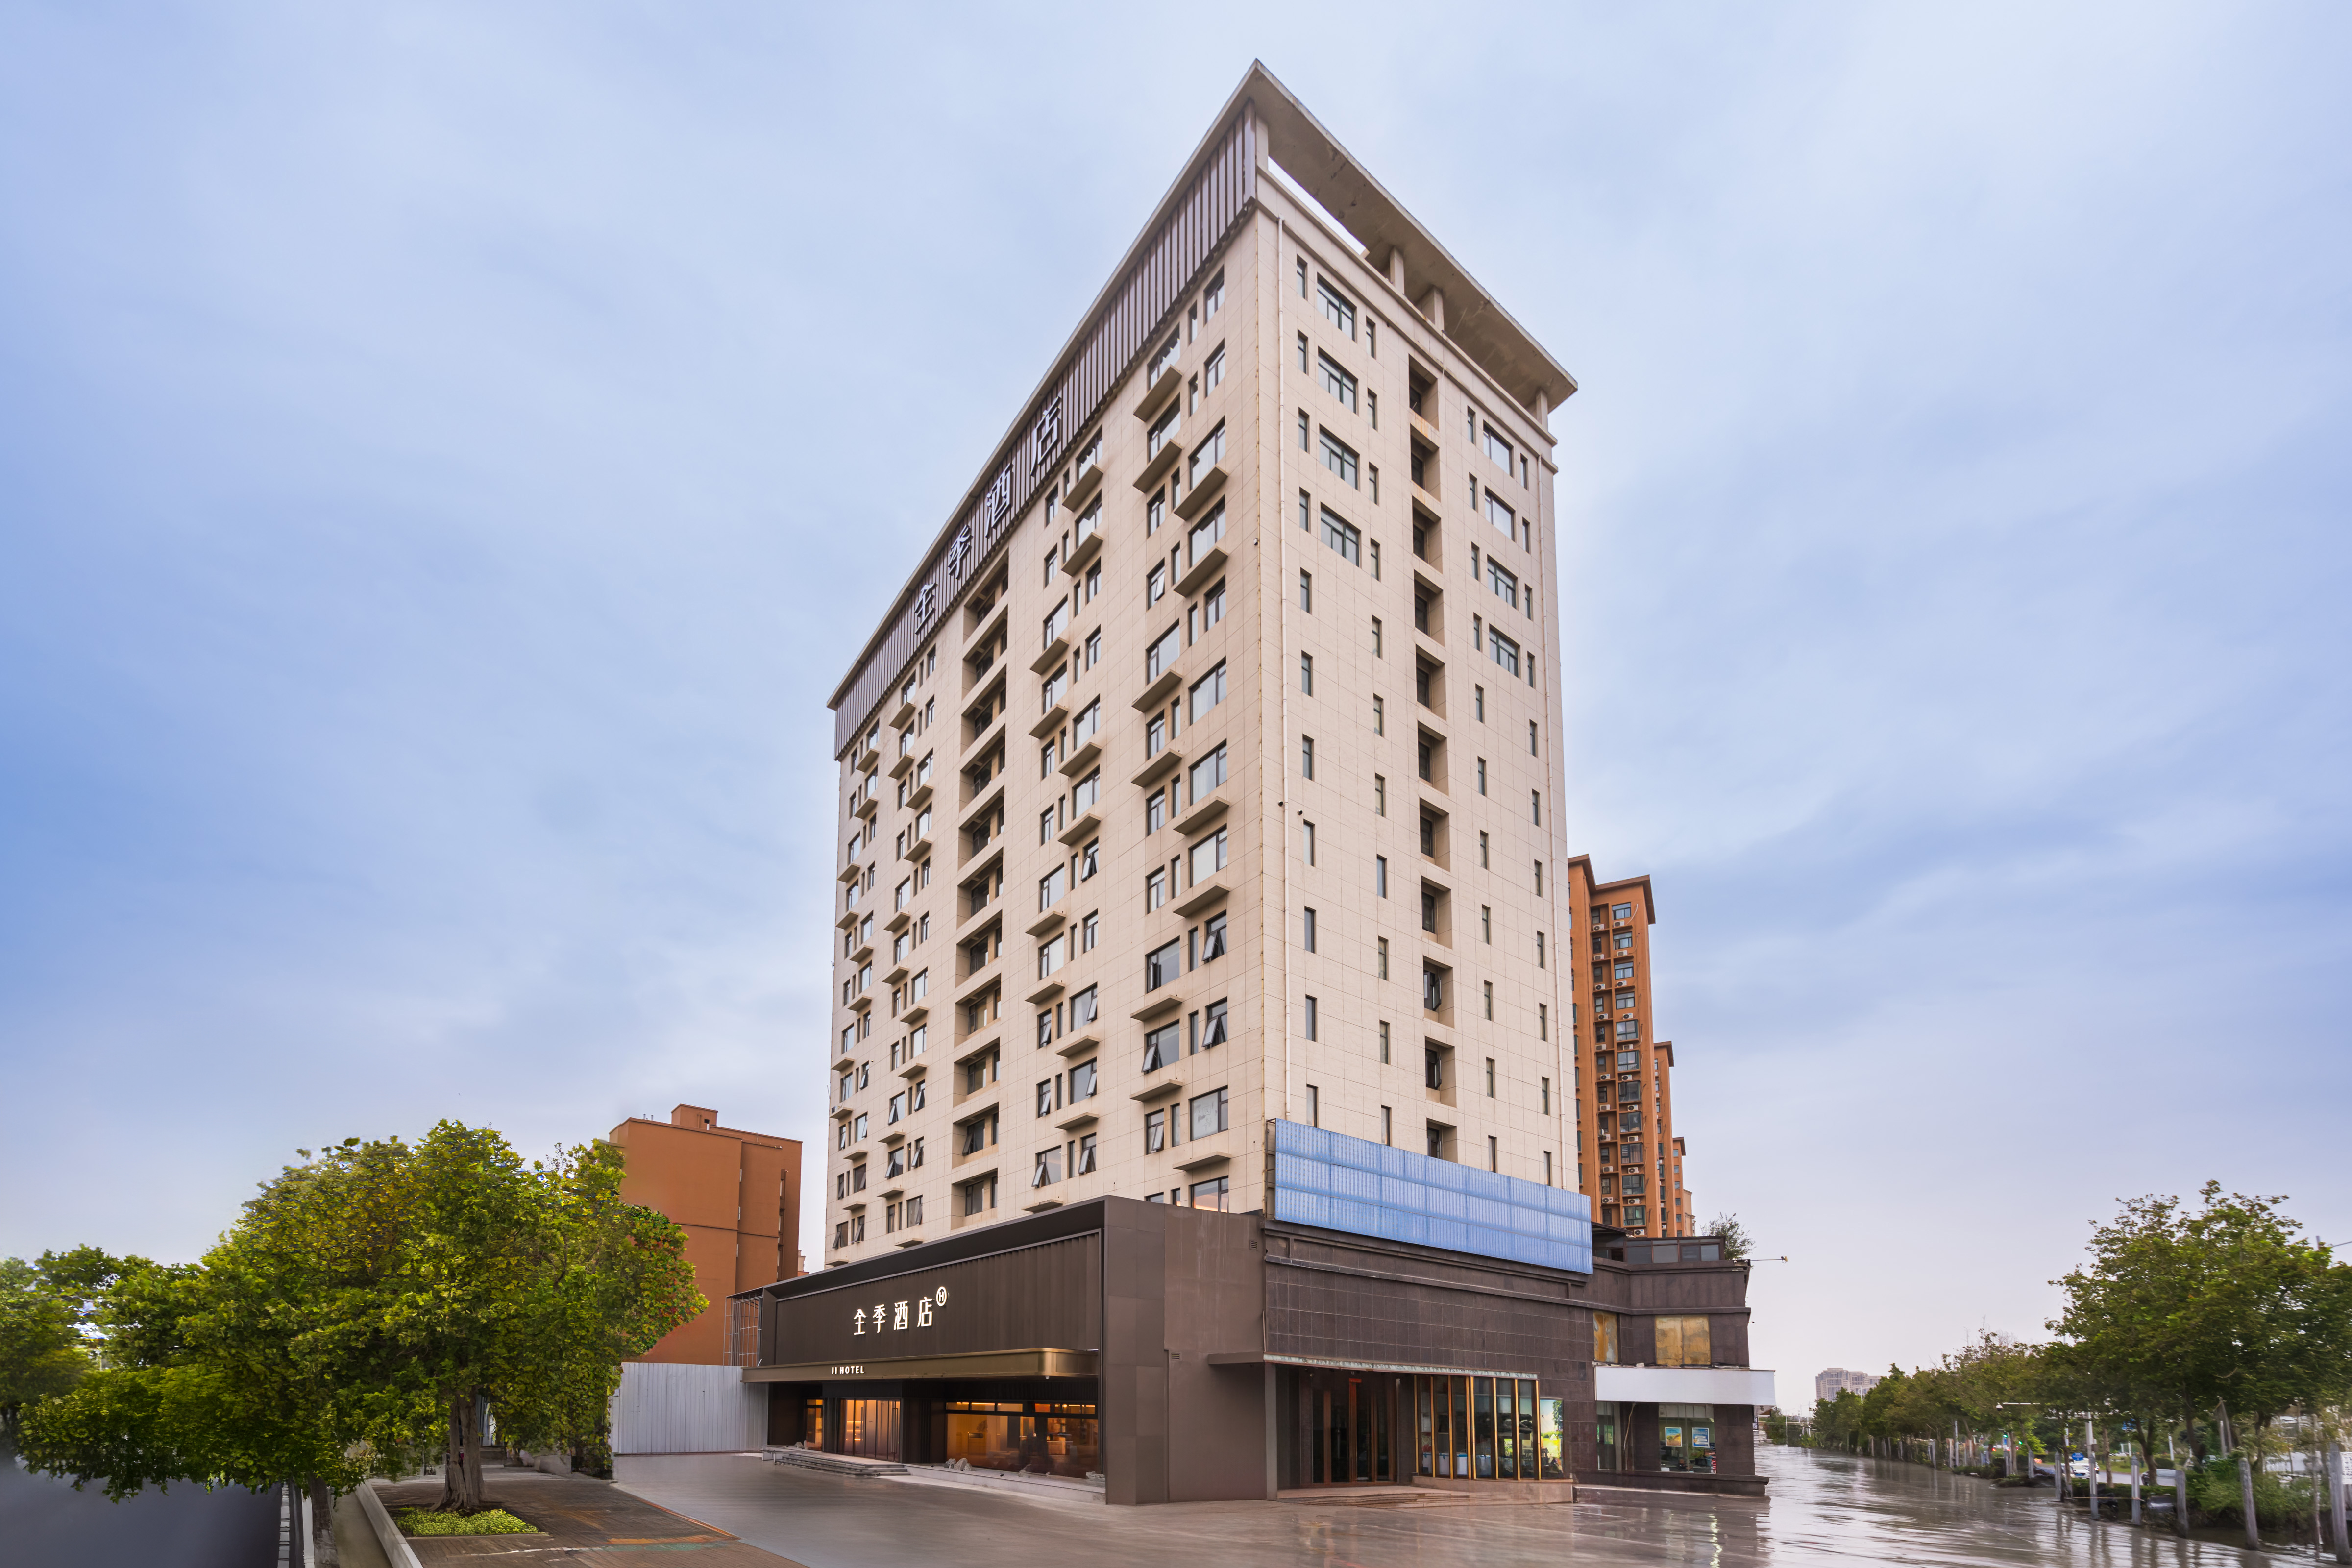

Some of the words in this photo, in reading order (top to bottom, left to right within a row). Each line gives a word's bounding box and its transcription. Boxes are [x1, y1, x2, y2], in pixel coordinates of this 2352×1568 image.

[914, 396, 1061, 635] 全季酒店
[853, 1296, 933, 1335] 全季酒店
[840, 1365, 865, 1374] HOTEL
